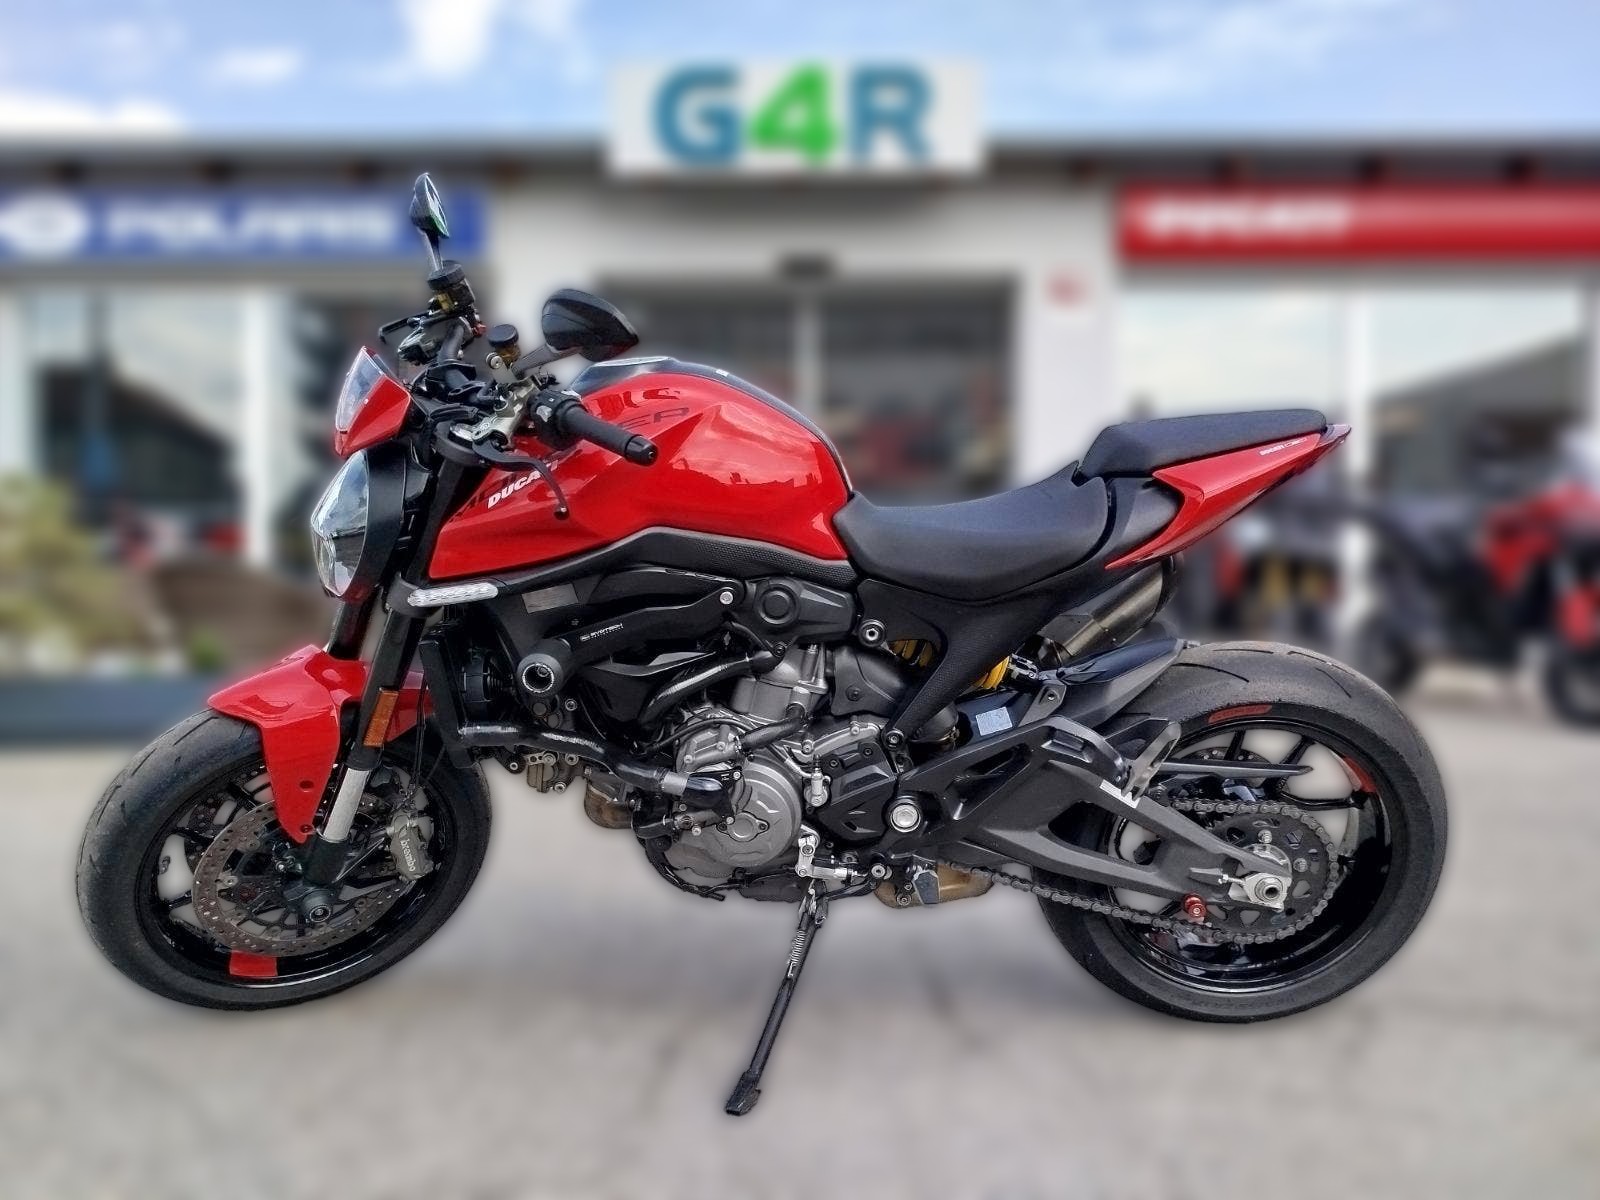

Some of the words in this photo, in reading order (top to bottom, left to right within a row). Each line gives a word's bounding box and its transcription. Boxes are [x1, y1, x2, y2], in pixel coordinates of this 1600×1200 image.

[654, 64, 933, 165] G4R
[487, 459, 559, 509] DUCAI
[400, 838, 417, 872] brembo
